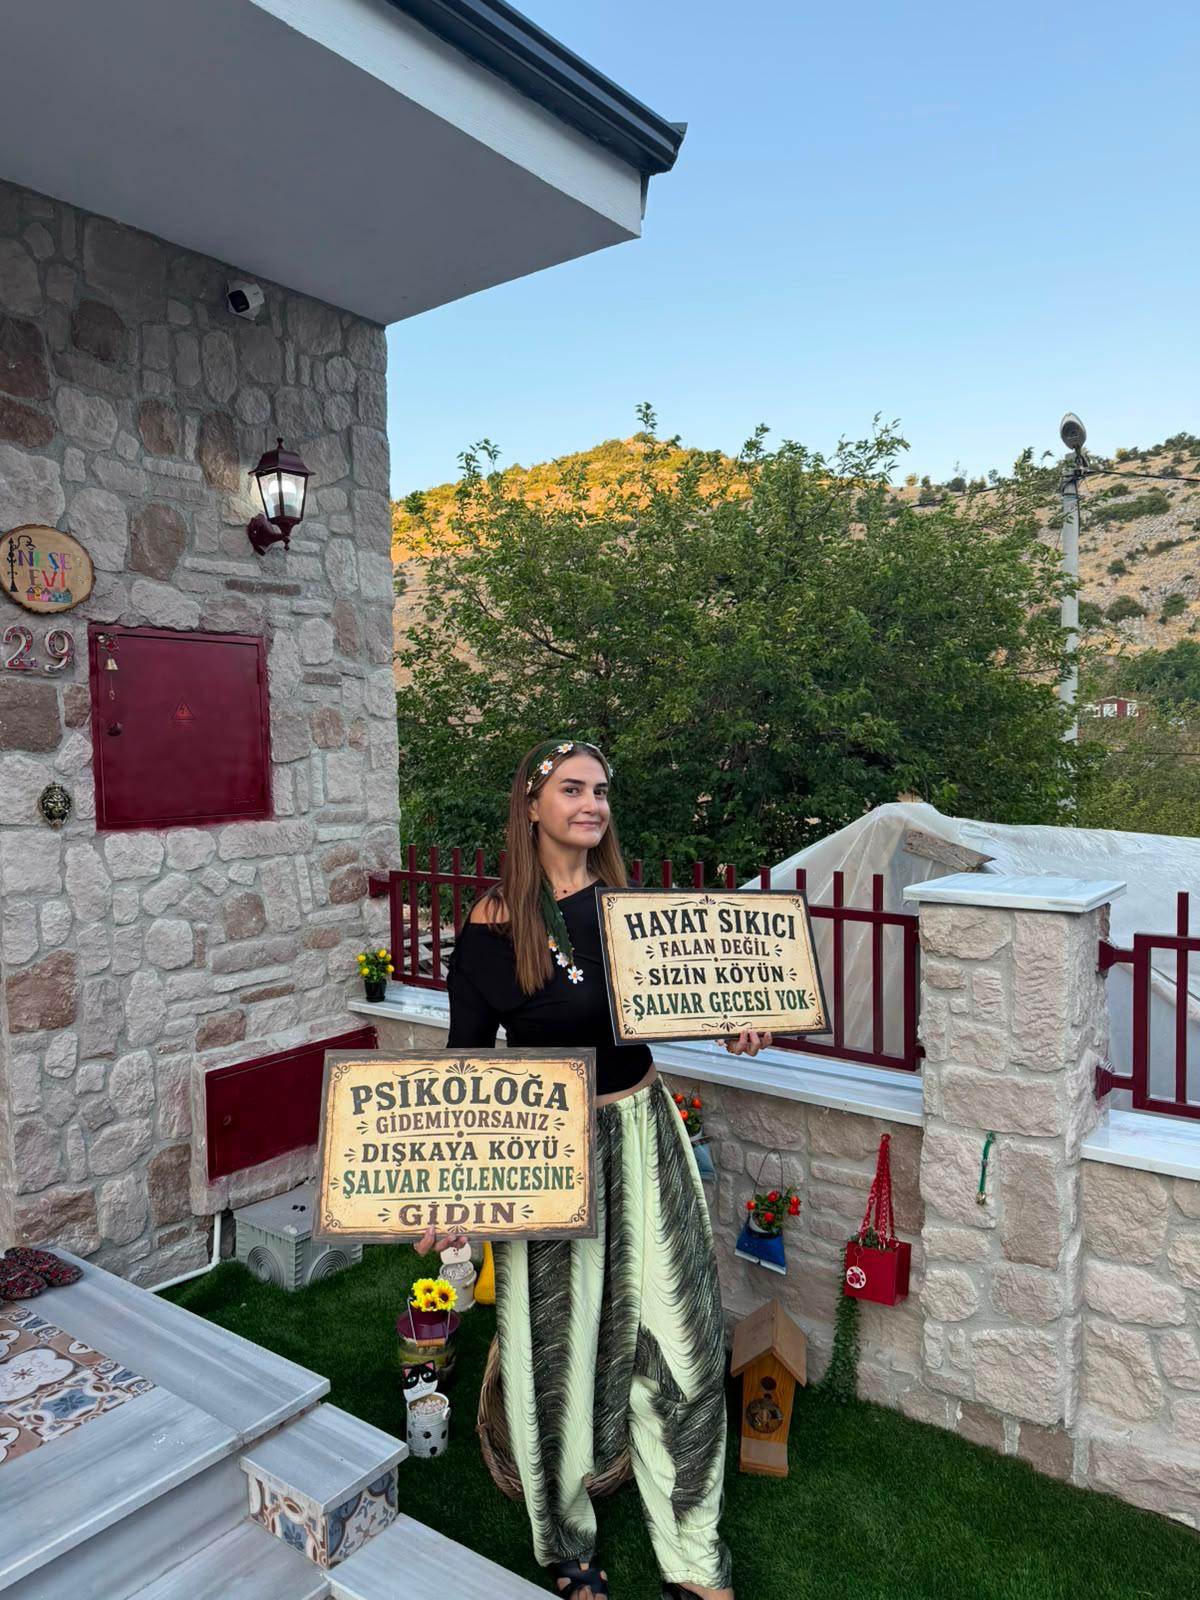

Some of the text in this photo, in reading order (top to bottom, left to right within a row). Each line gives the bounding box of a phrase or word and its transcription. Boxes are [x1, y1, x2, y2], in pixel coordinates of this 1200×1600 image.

[3, 624, 76, 672] 29
[624, 908, 796, 940] HAYAT SIKICI
[659, 936, 770, 958] FALAN DEĞİL
[648, 962, 785, 986] SİZİN KÖYÜN
[632, 986, 810, 1021] ŞALVAR GECESİ YOK
[350, 1073, 570, 1115] PSİKOLOĞA
[376, 1107, 550, 1134] GİDEMİYORSANIZ
[361, 1136, 559, 1167] DIŞKAYA KÖYÜ
[342, 1162, 575, 1199] ŞALVAR EĞLENCESİNE
[399, 1201, 516, 1226] GİDİN
